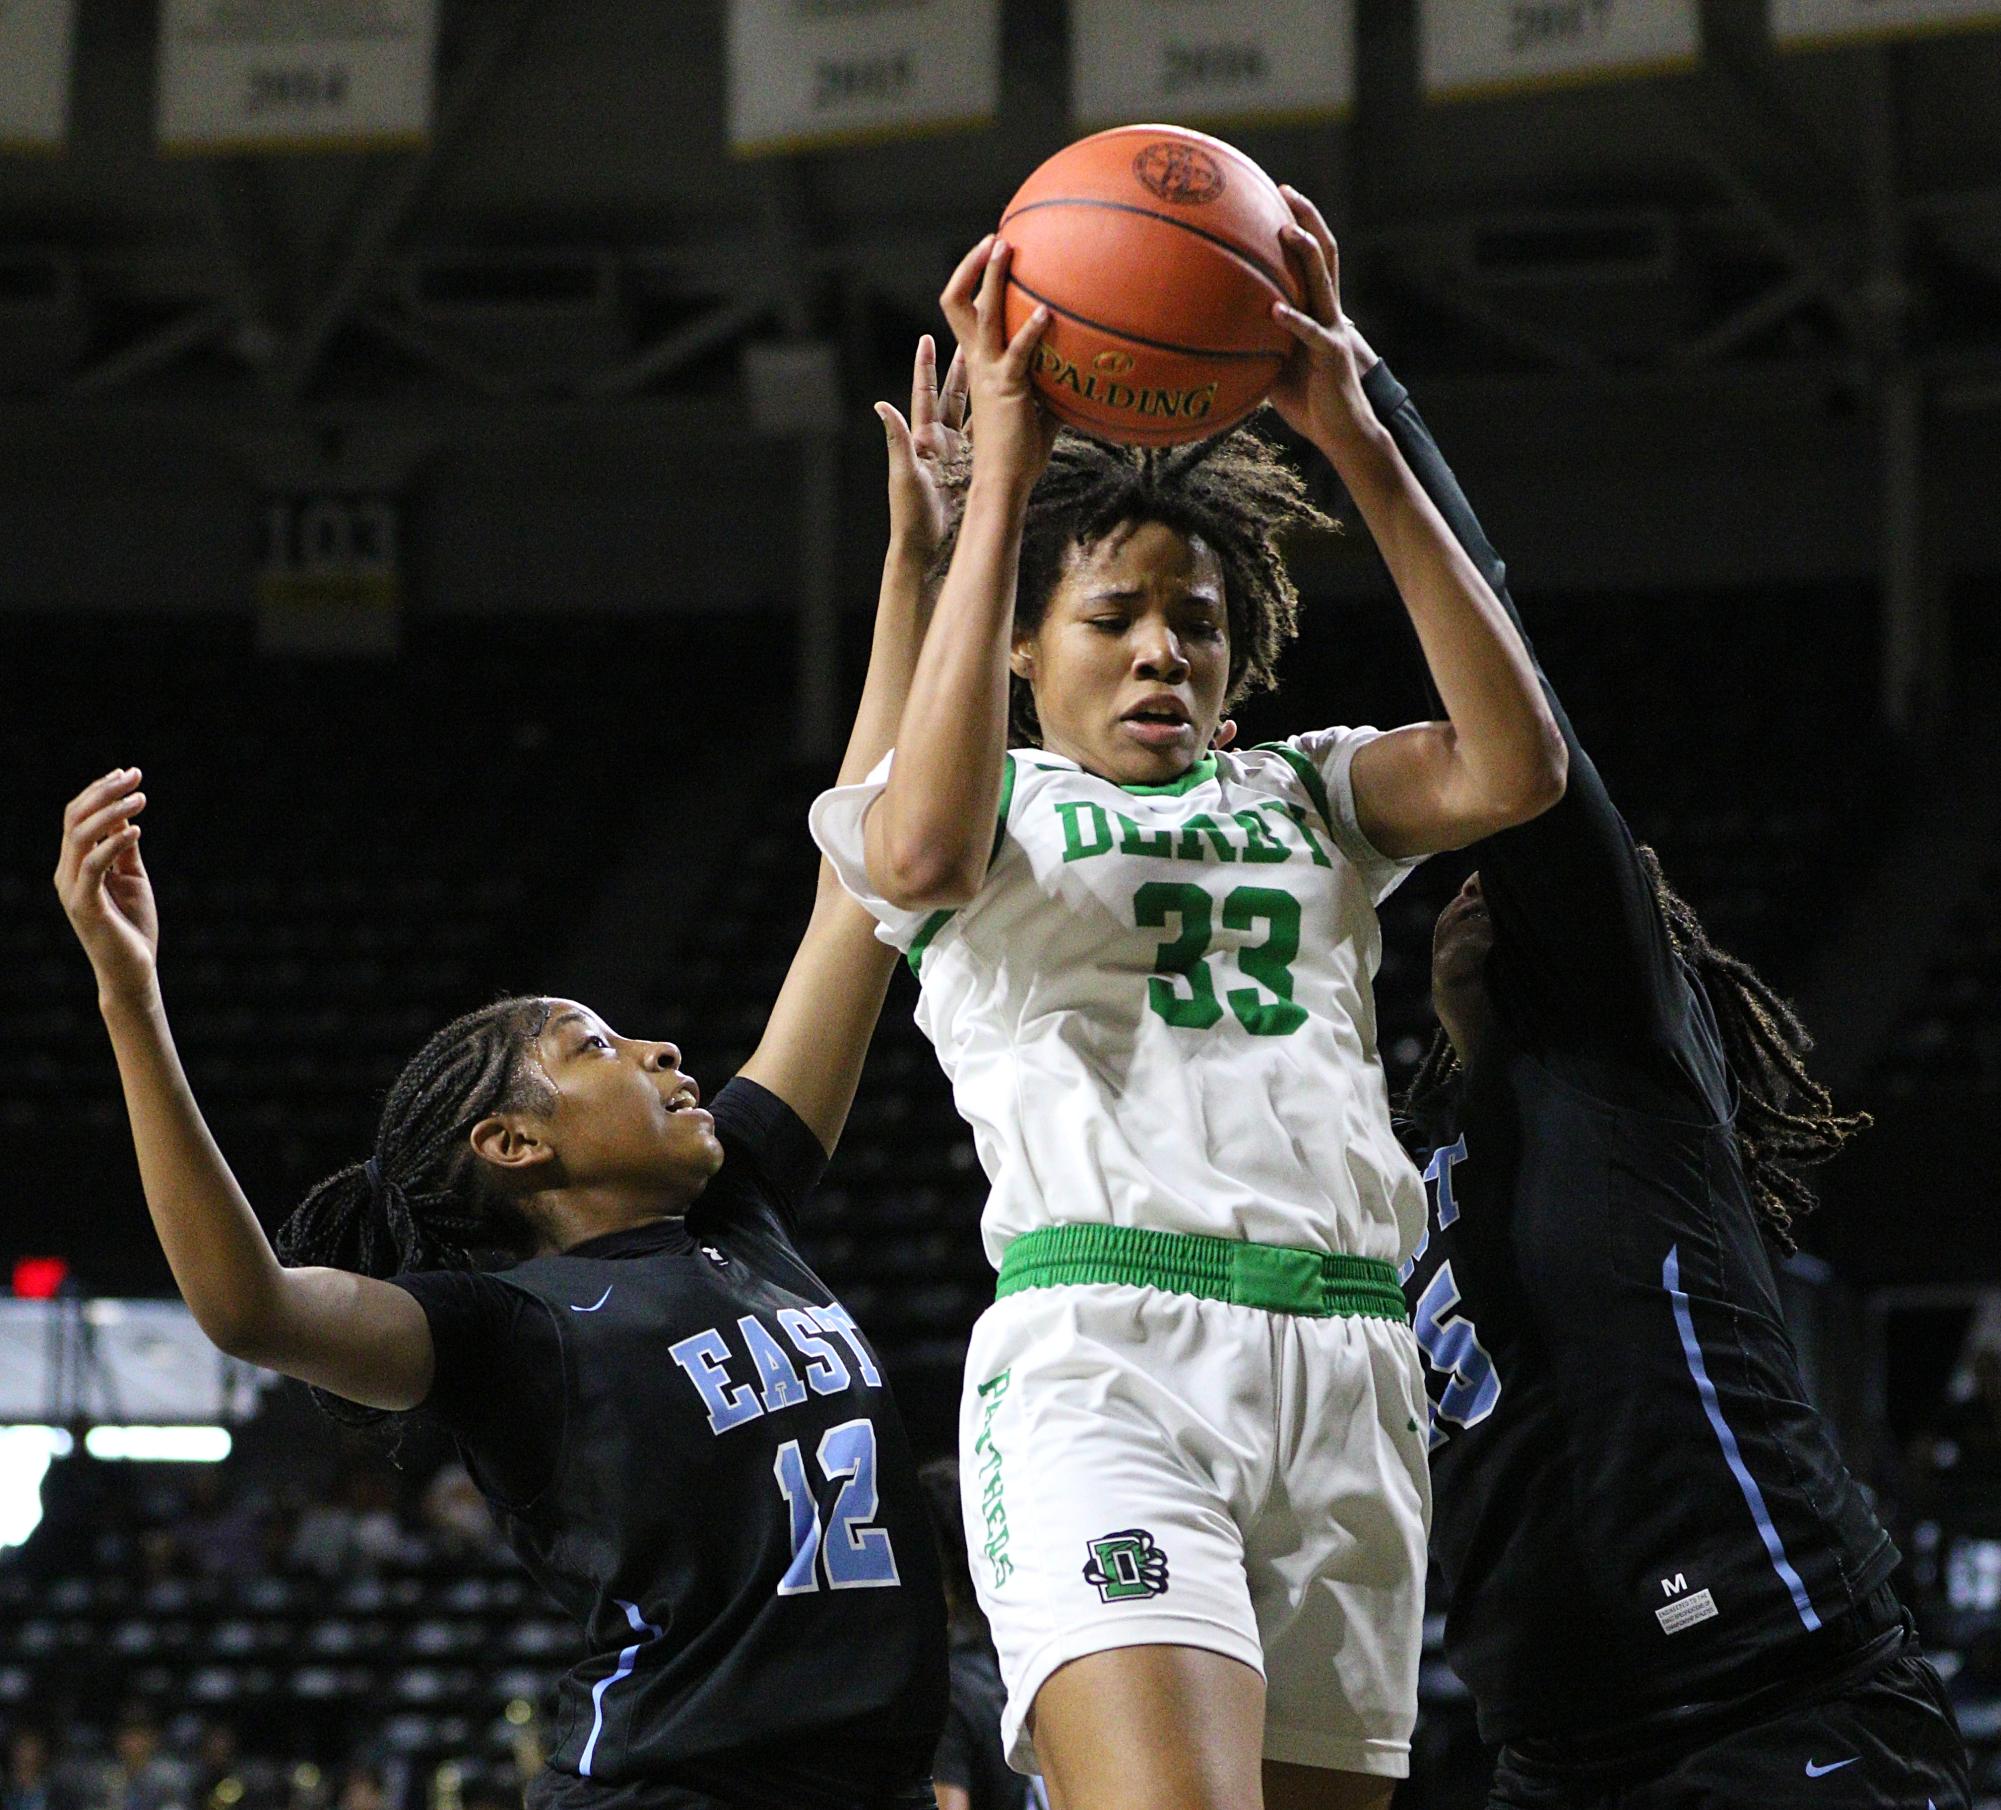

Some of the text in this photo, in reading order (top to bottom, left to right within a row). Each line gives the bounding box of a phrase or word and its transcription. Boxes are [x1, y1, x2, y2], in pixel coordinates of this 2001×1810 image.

[1034, 343, 1218, 419] PALDING
[1133, 881, 1310, 1036] 33
[667, 1302, 883, 1436] EAST
[1412, 1258, 1502, 1450] 5
[773, 1418, 902, 1596] 12
[1660, 1572, 1688, 1598] M
